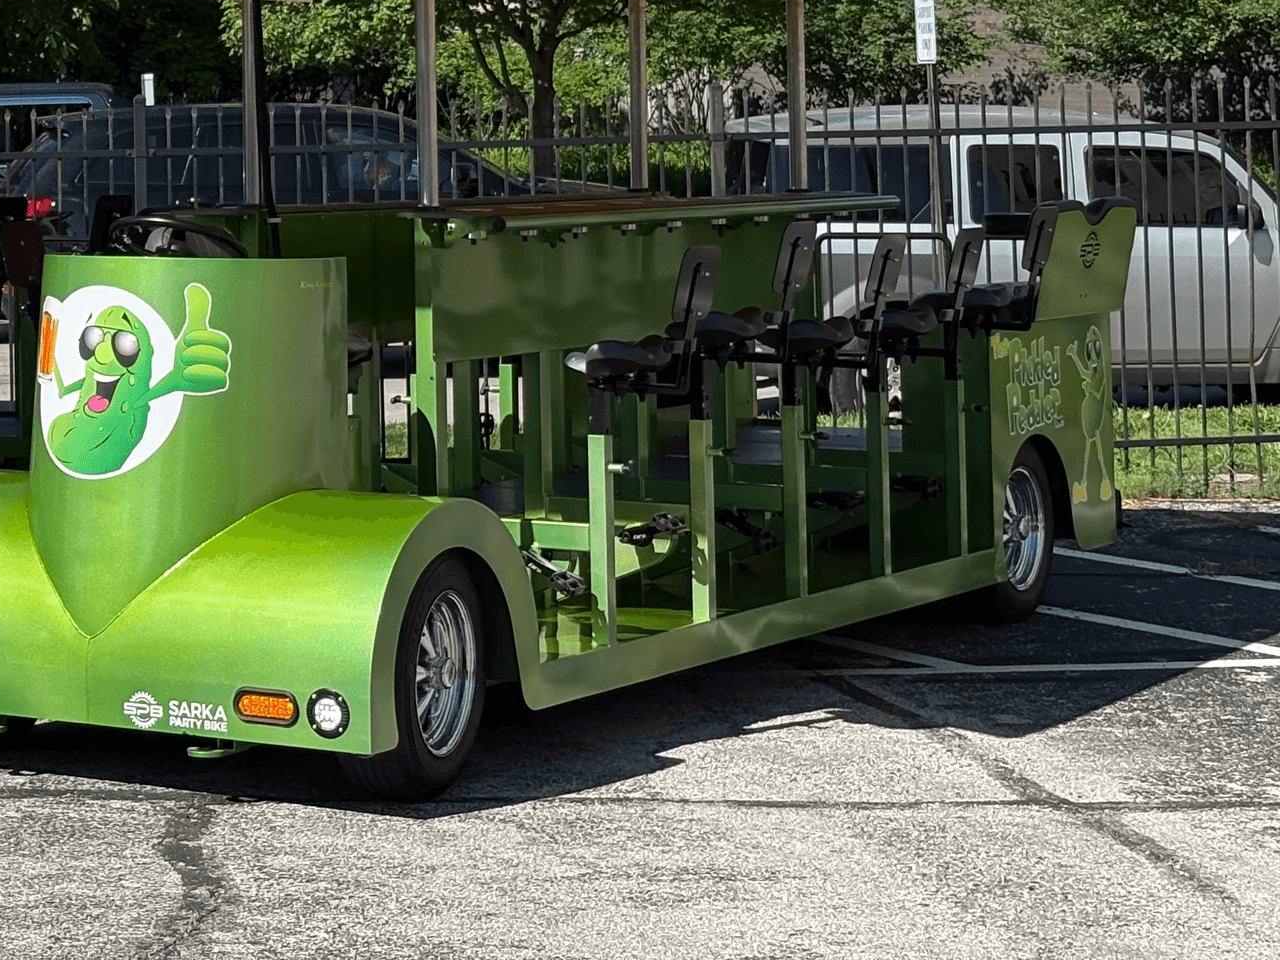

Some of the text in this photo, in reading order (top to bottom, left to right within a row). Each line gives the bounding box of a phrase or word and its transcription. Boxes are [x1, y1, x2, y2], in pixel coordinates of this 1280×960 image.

[1008, 335, 1061, 387] Pickled
[123, 701, 164, 718] SPB
[168, 700, 228, 722] SARKA
[169, 716, 229, 733] PARTY BIKE
